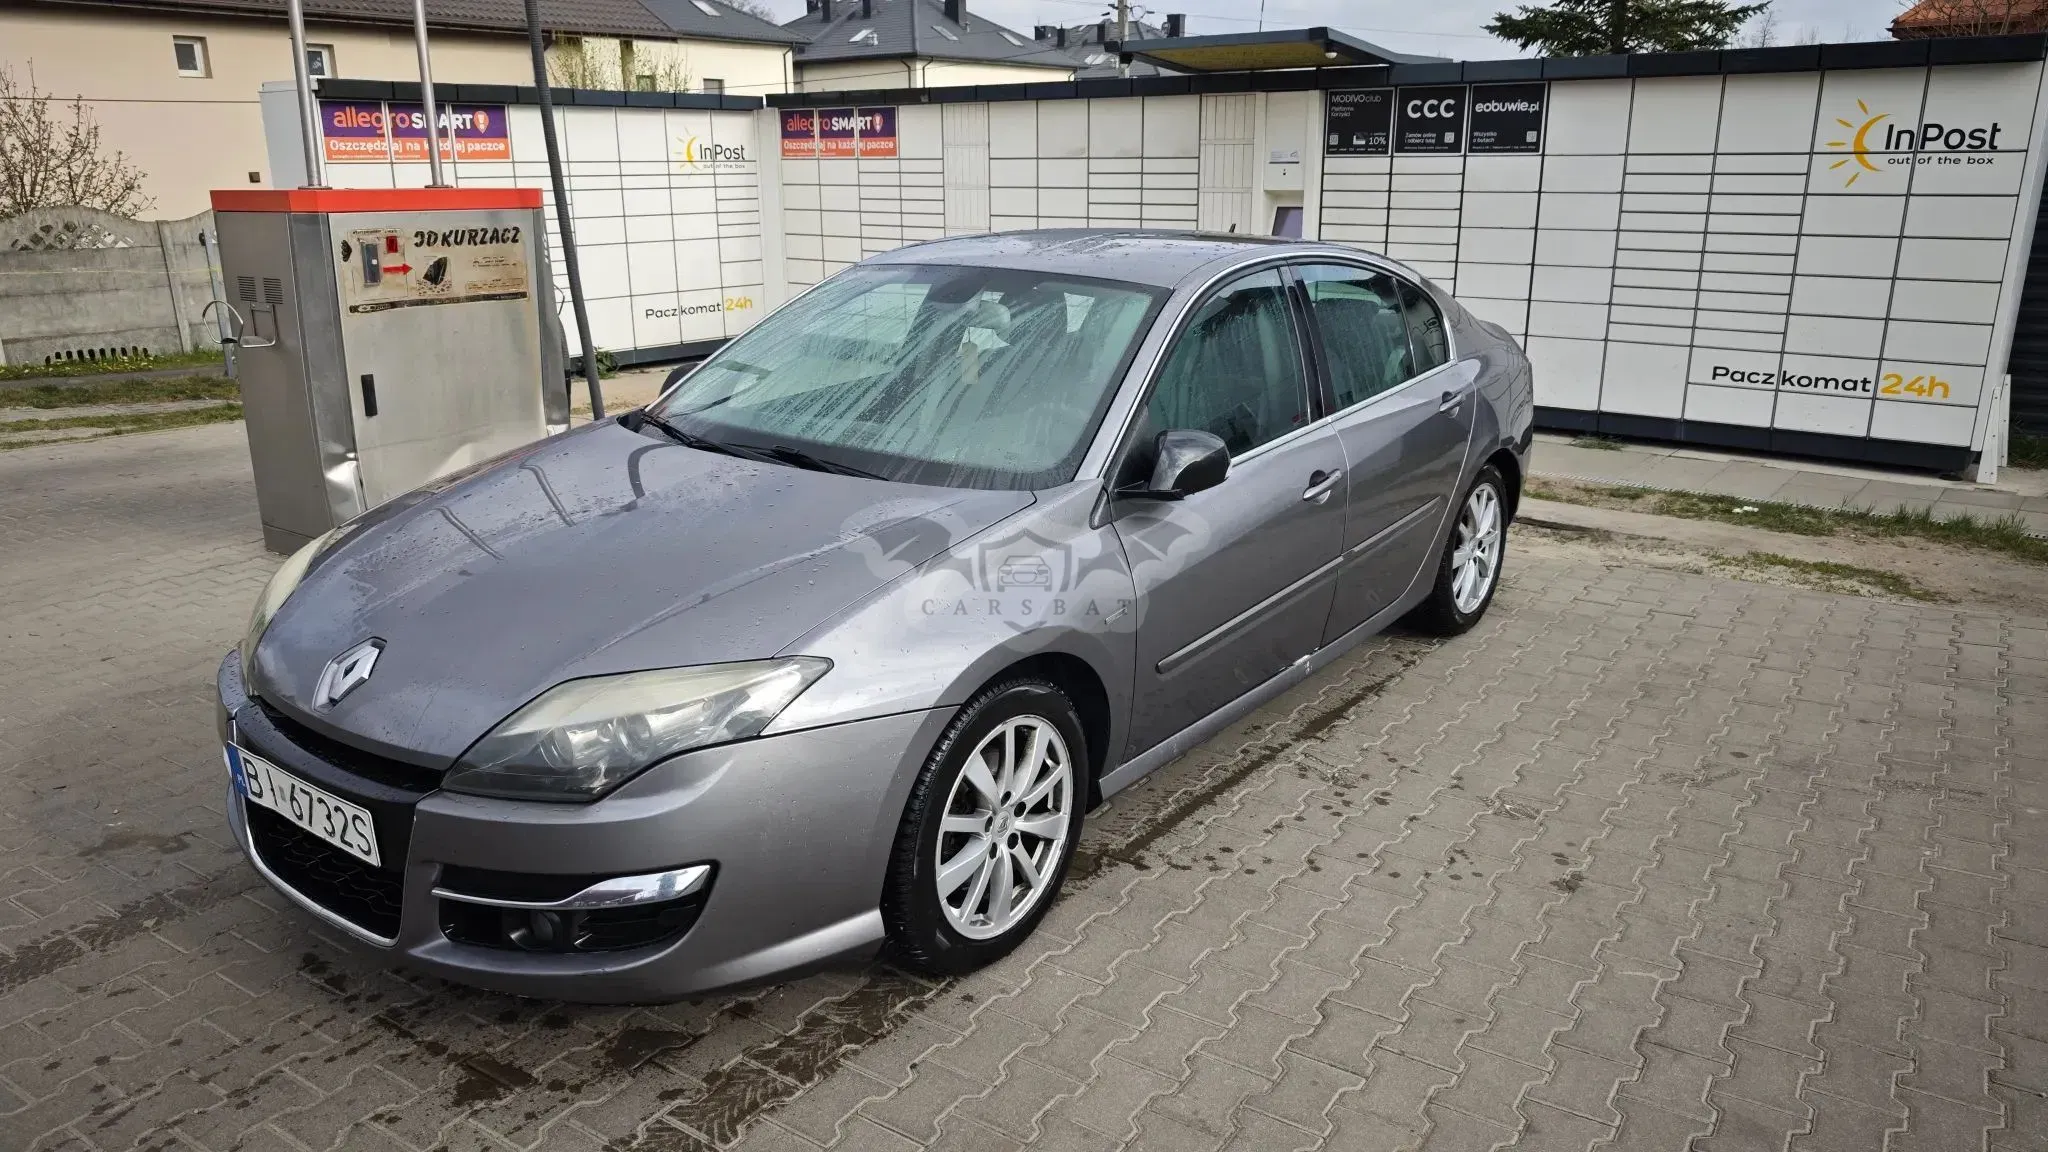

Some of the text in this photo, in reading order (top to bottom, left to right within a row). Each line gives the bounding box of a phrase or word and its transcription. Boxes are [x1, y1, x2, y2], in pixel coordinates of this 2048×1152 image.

[1407, 98, 1456, 119] CCC
[1475, 99, 1540, 114] eobuwie.pl
[333, 106, 410, 134] allegro
[787, 113, 832, 135] allegro
[406, 141, 420, 151] na
[467, 141, 505, 152] paczce
[828, 141, 837, 149] na
[867, 141, 894, 150] paczce
[1368, 136, 1387, 145] 10%
[1884, 122, 2002, 151] InPost
[699, 143, 746, 161] InPost
[1887, 155, 1995, 165] out of the box
[645, 296, 753, 319] Paczkomat 24h
[1711, 365, 1950, 399] Paczkomat 24h
[290, 782, 372, 856] 6732S
